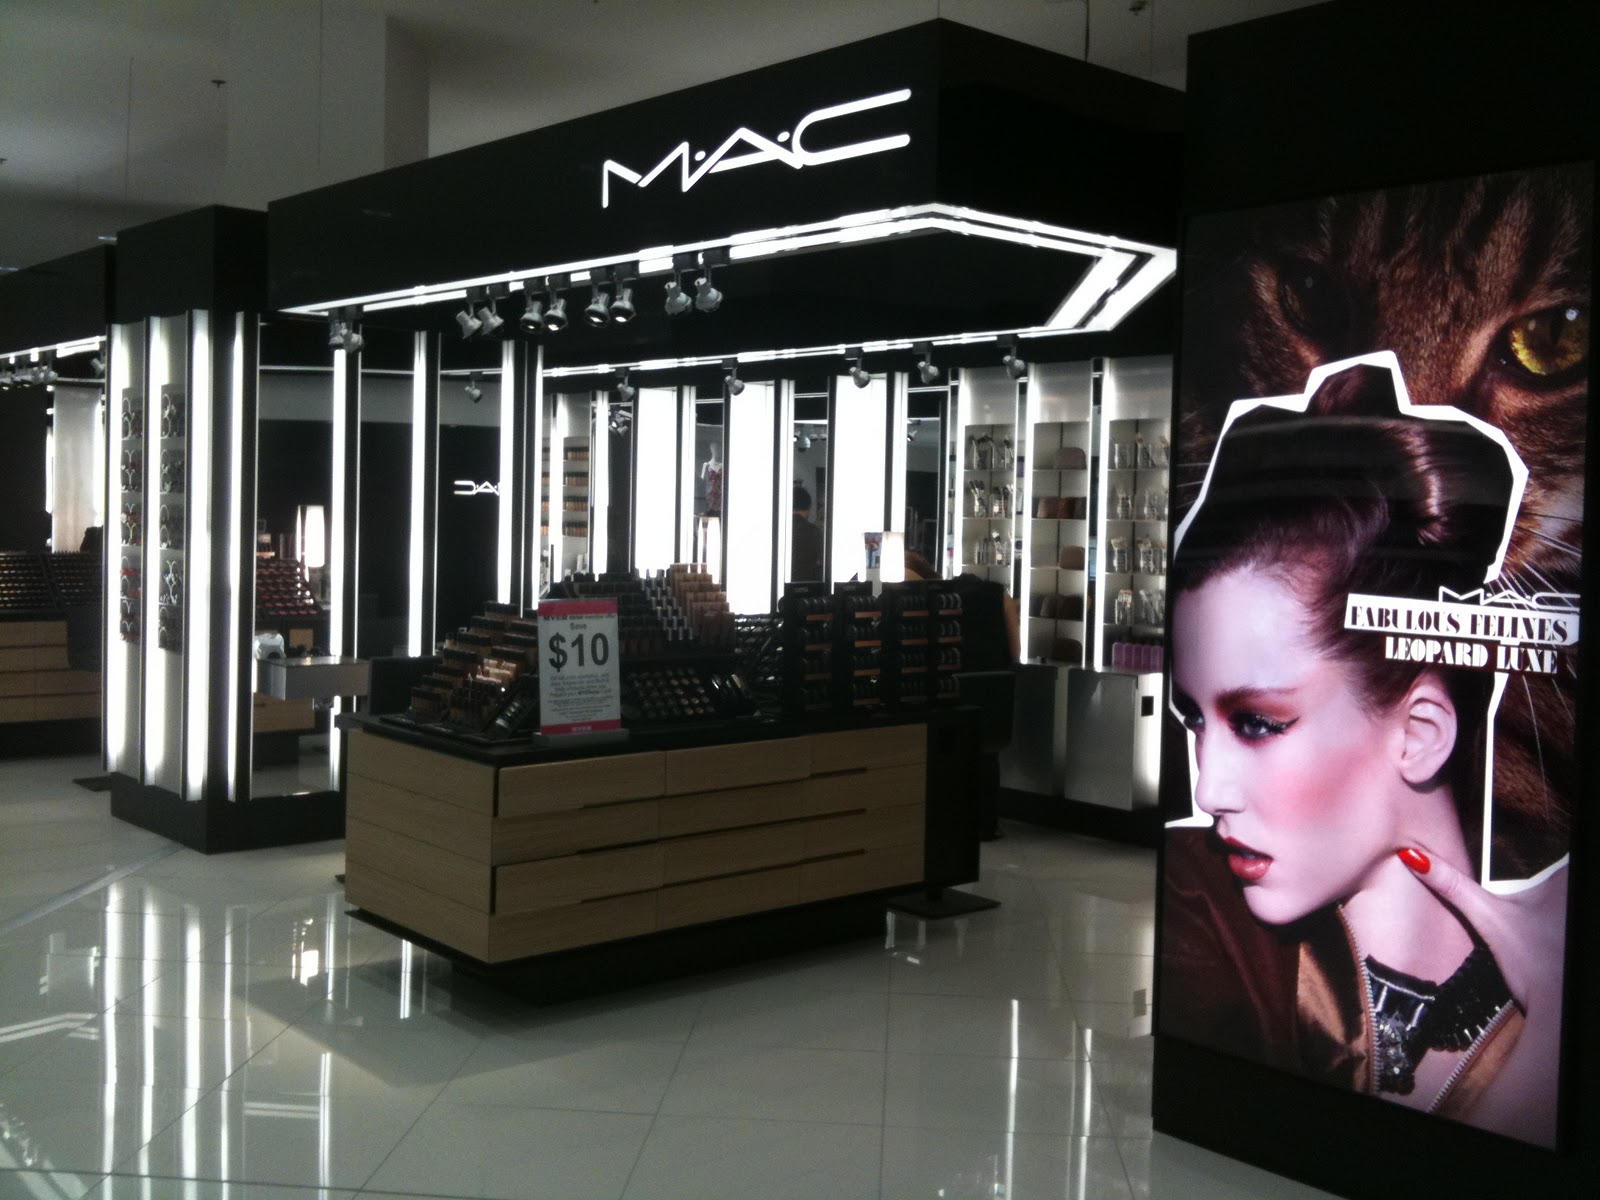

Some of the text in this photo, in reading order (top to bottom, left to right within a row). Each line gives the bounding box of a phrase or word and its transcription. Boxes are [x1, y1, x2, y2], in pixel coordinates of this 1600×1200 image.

[569, 622, 587, 631] Save
[1351, 605, 1568, 643] FABULOUS FELINES
[549, 632, 609, 672] $10
[1385, 636, 1558, 674] LEOPARD LUXE
